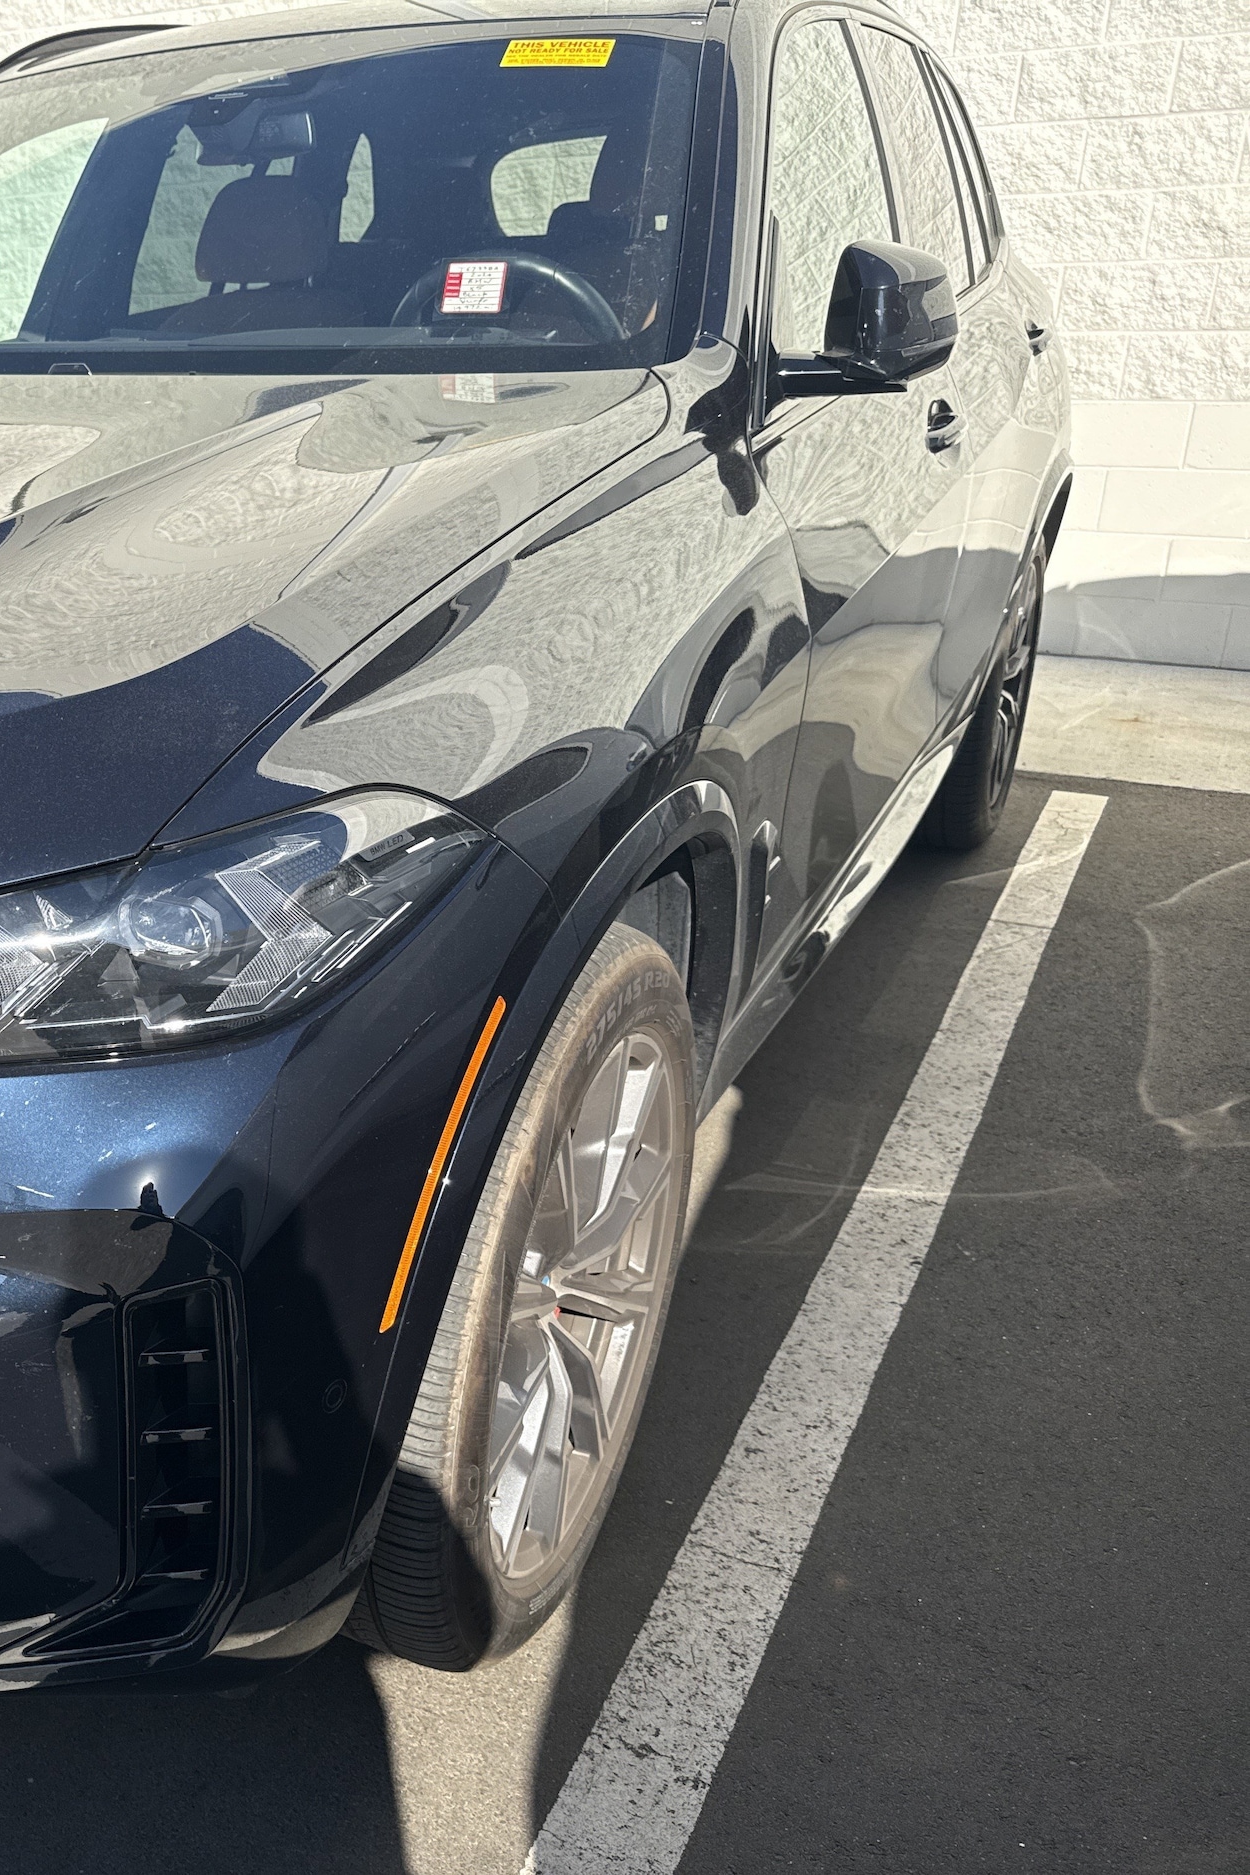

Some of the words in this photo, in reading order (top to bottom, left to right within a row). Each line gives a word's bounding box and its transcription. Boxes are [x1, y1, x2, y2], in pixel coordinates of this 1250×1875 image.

[370, 843, 386, 856] BMW
[387, 834, 403, 847] LED
[586, 976, 642, 1065] 275/45
[644, 970, 670, 991] R20
